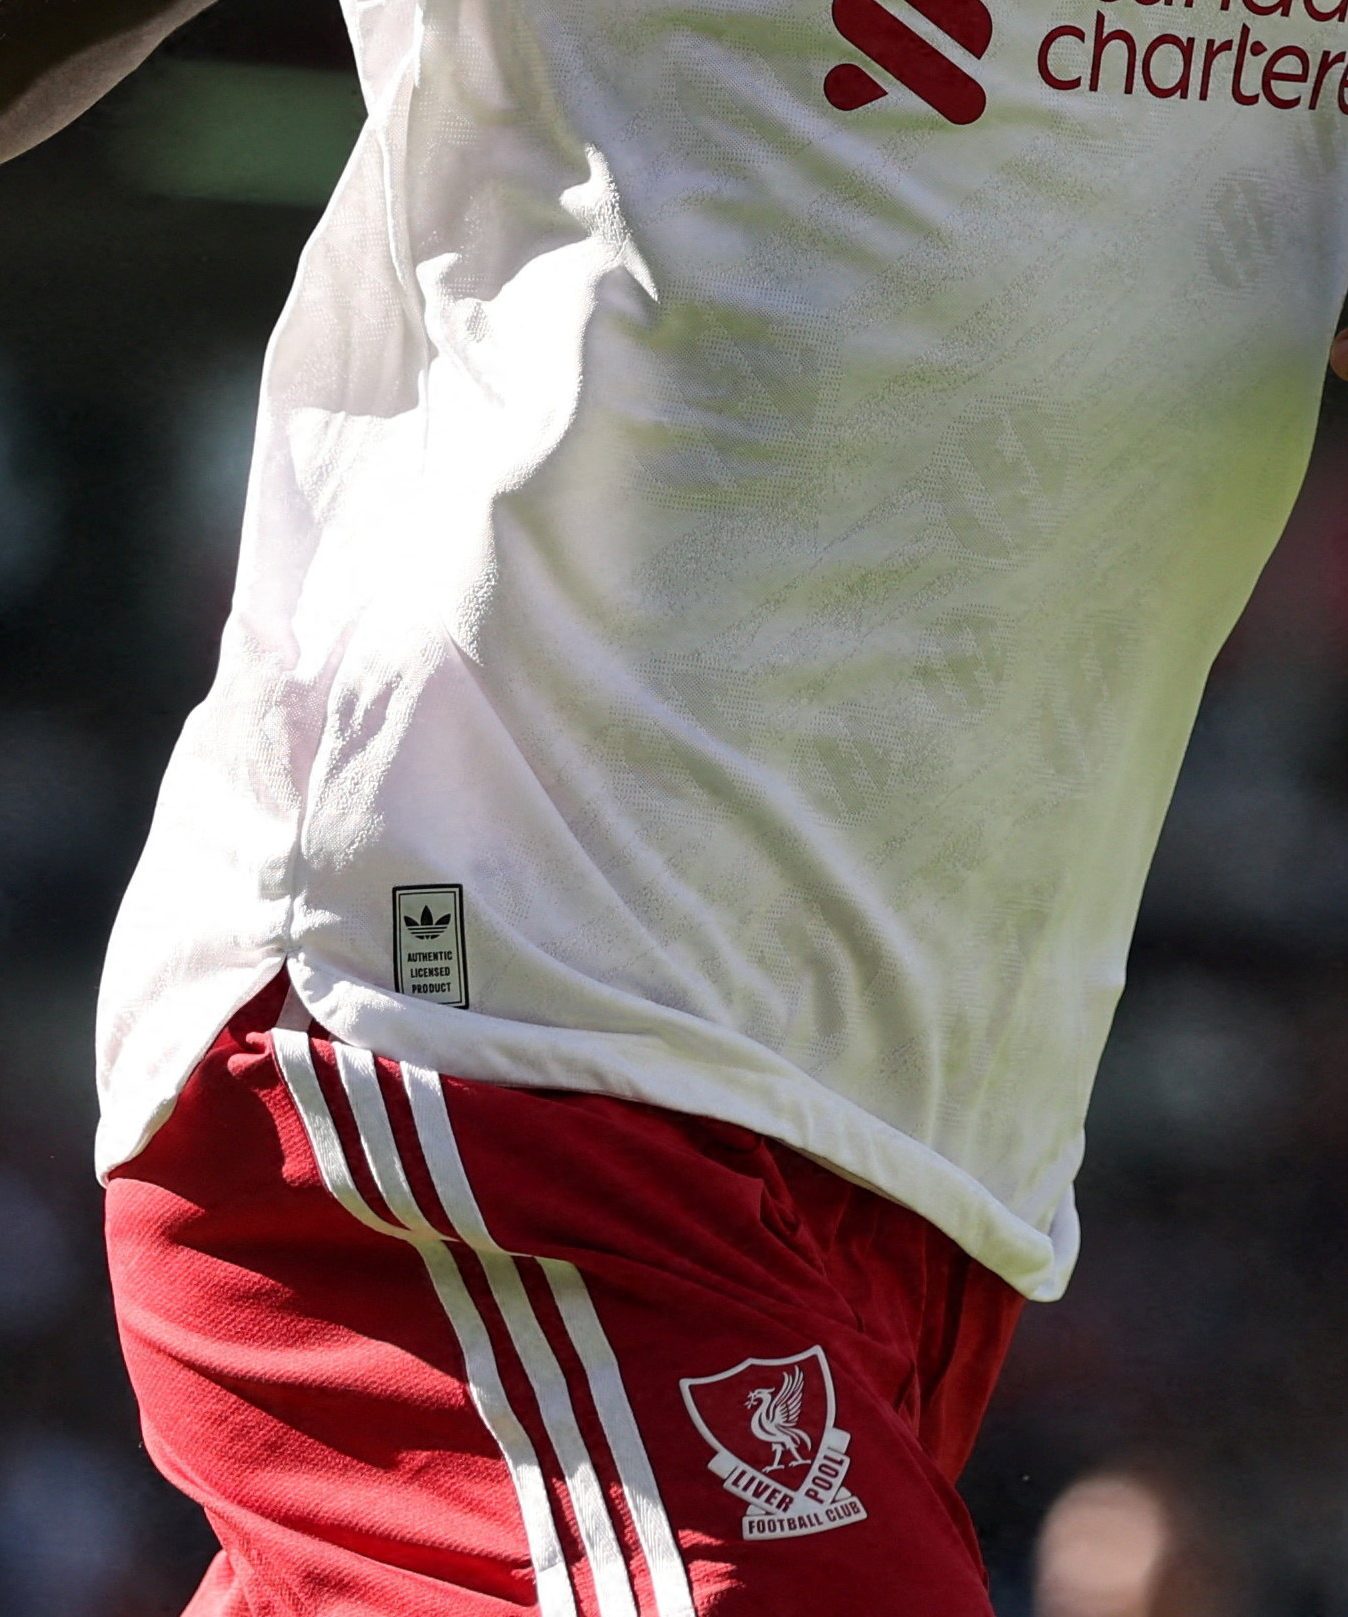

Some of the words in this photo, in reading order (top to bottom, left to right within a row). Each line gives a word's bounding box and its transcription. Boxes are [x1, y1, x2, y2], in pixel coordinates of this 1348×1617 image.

[407, 950, 453, 963] AUTHENTIC
[410, 966, 451, 979] LICENSED
[411, 982, 452, 995] PRODUCT
[731, 1469, 795, 1514] LIVER
[804, 1454, 845, 1505] POOL
[748, 1513, 824, 1535] FOOTBALL
[825, 1501, 862, 1522] CLUB
